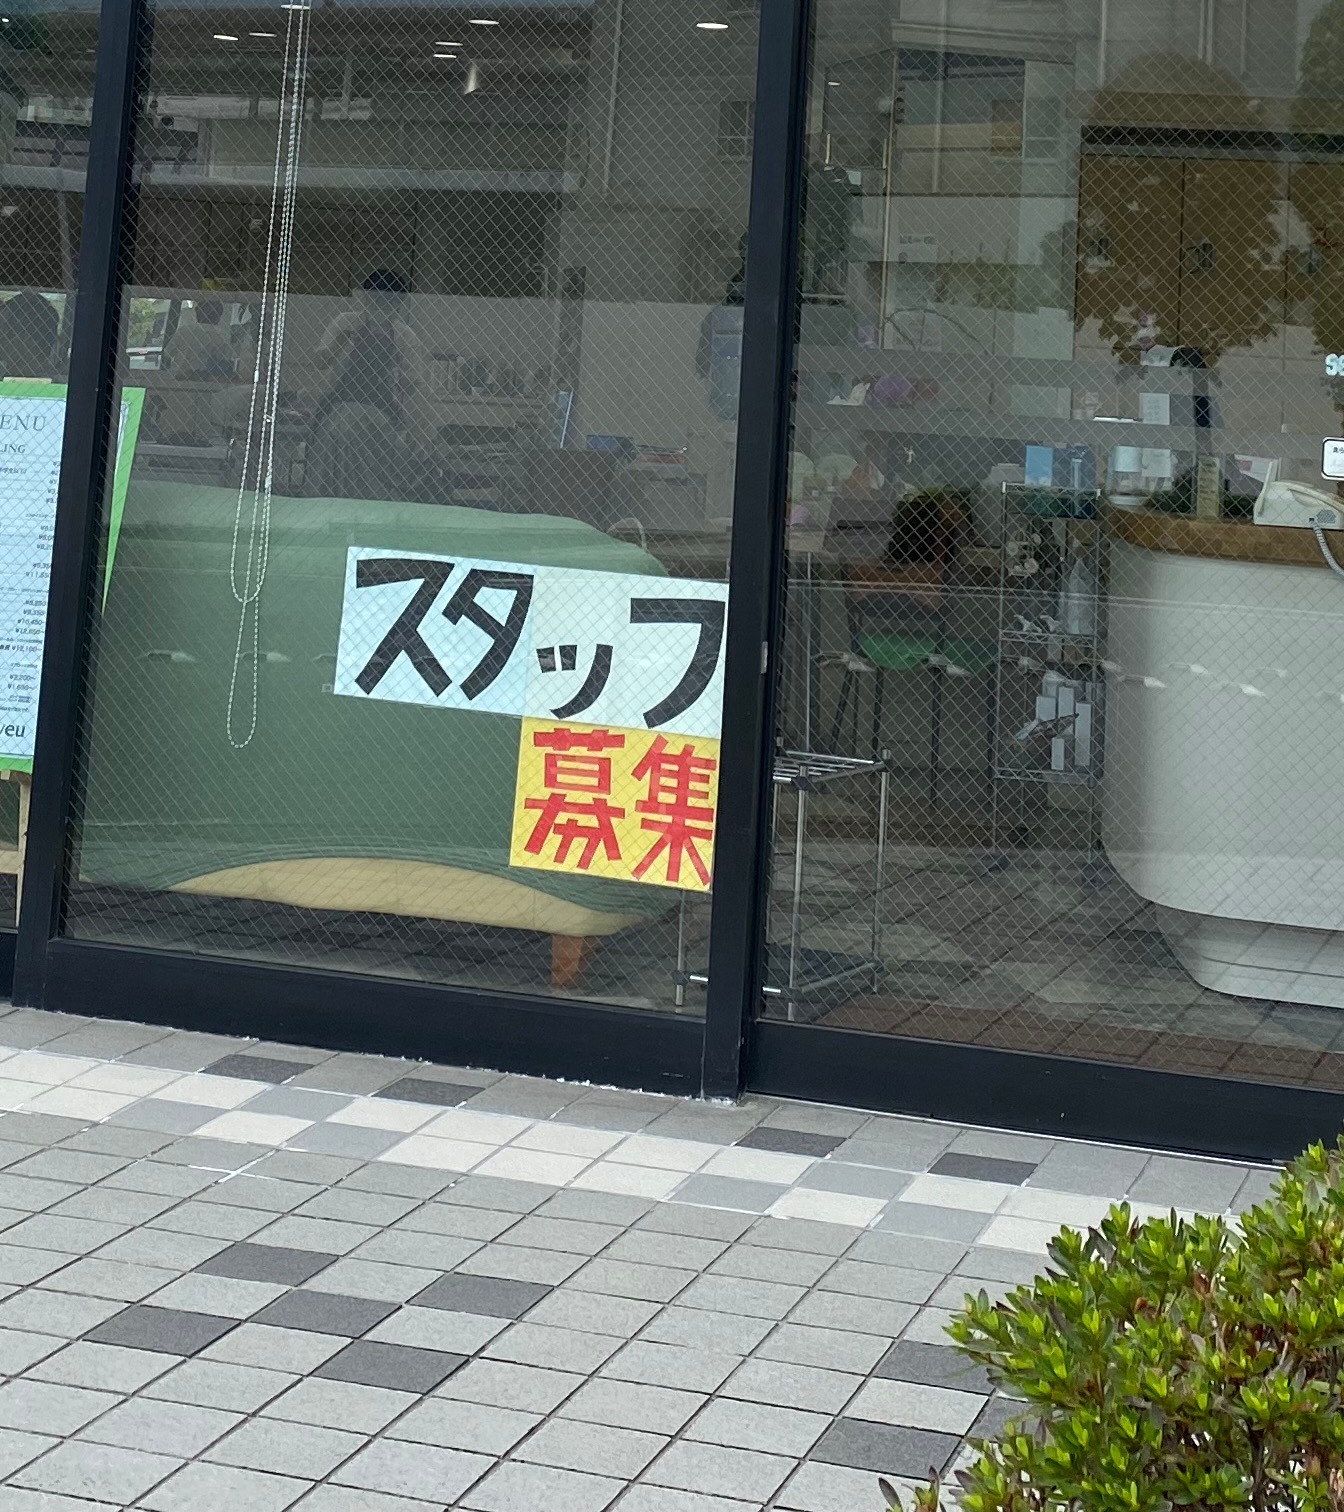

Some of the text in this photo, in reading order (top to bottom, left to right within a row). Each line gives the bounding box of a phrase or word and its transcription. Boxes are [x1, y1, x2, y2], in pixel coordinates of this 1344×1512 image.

[354, 557, 726, 729] スタッフ
[524, 727, 716, 887] 募集
